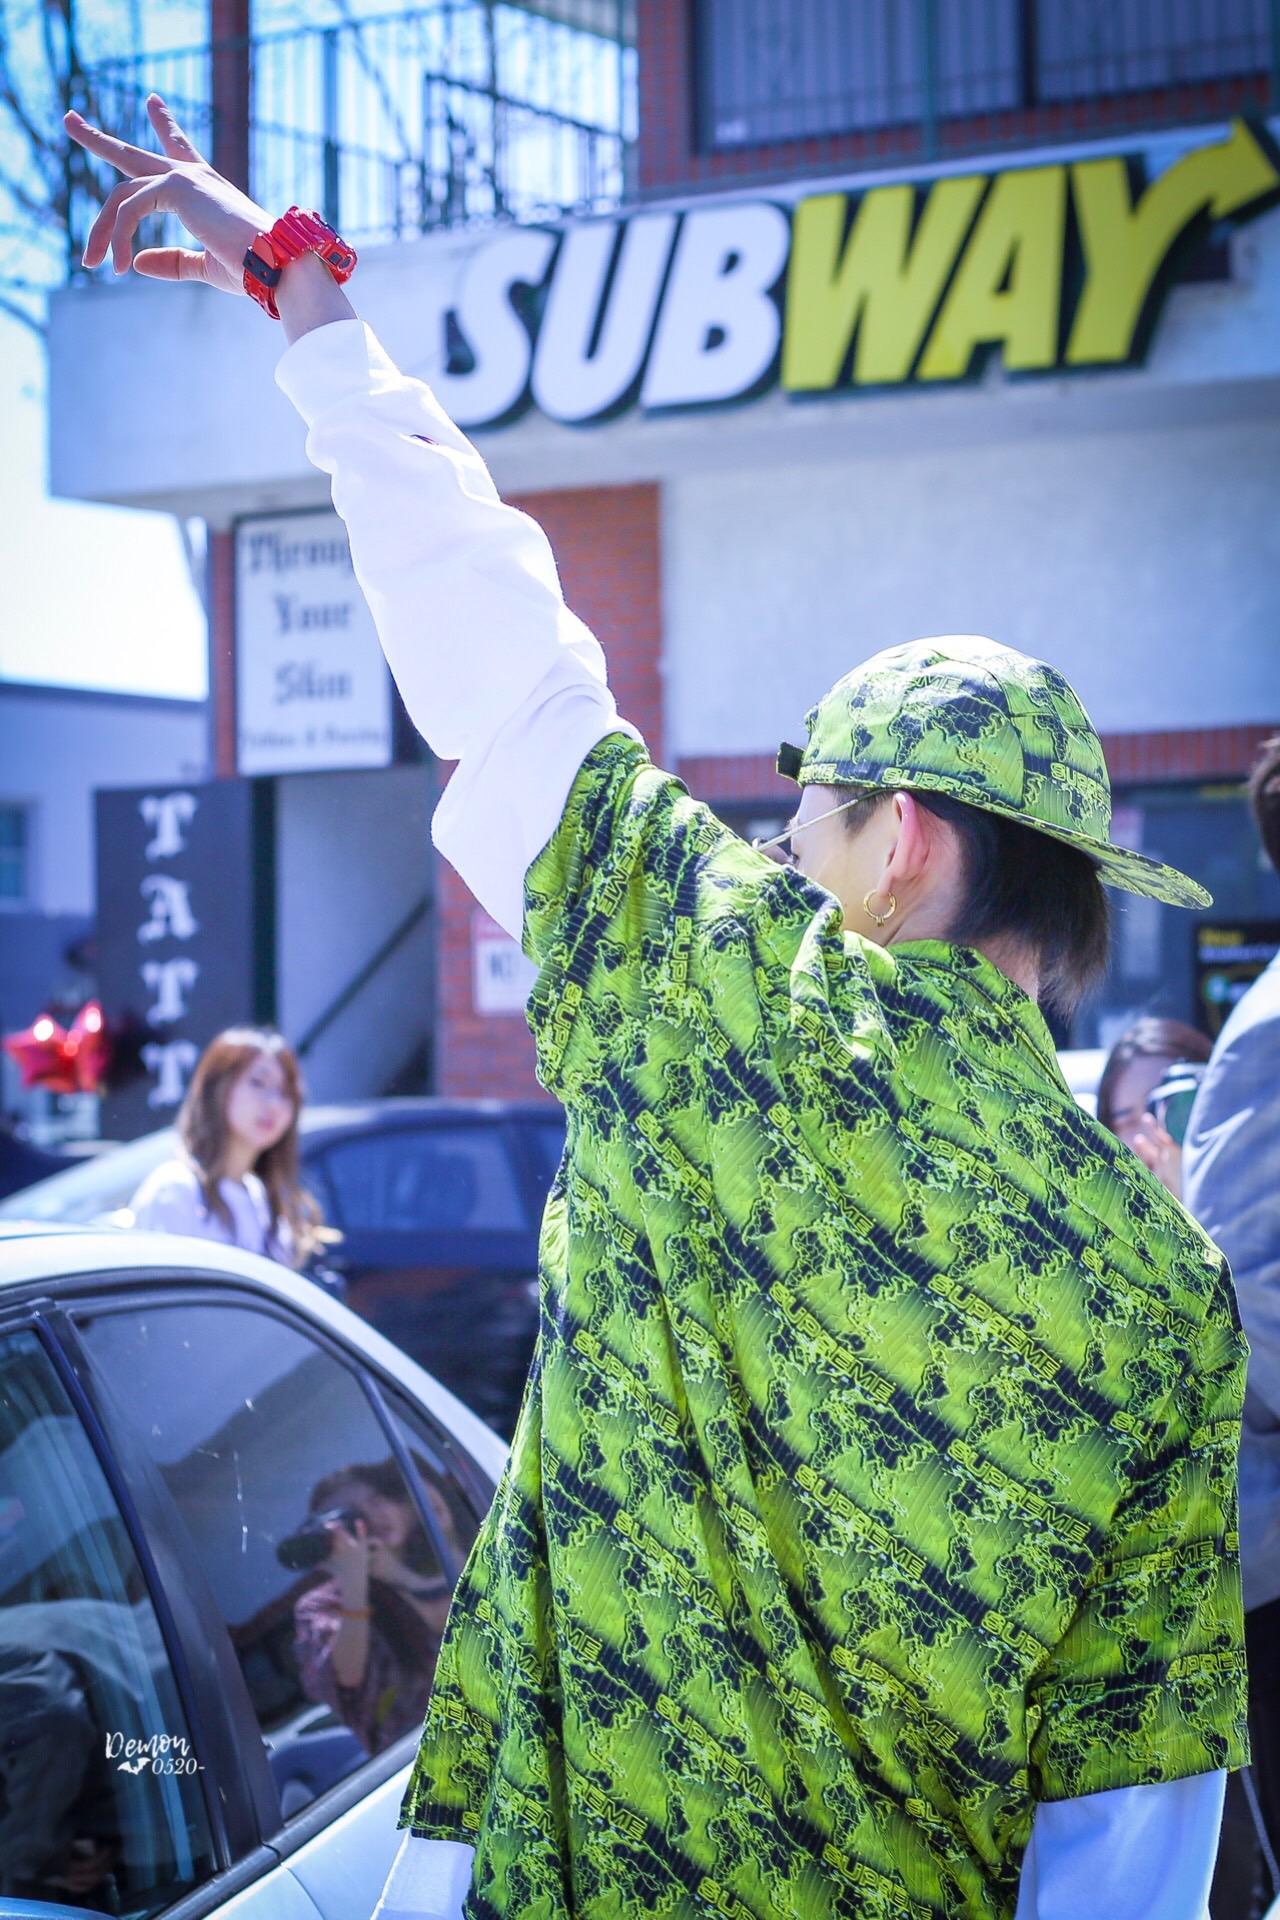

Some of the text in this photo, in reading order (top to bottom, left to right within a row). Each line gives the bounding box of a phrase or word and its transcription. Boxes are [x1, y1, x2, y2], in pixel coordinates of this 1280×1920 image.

[441, 119, 1278, 428] SUBWAY
[898, 1116, 1030, 1213] SUPREME
[769, 1281, 896, 1404] SUPREME
[928, 1273, 1061, 1381] SUPREME
[573, 1329, 681, 1437] SUPREME
[795, 1464, 927, 1580] SUPREME
[948, 1439, 1091, 1544] SUPREME
